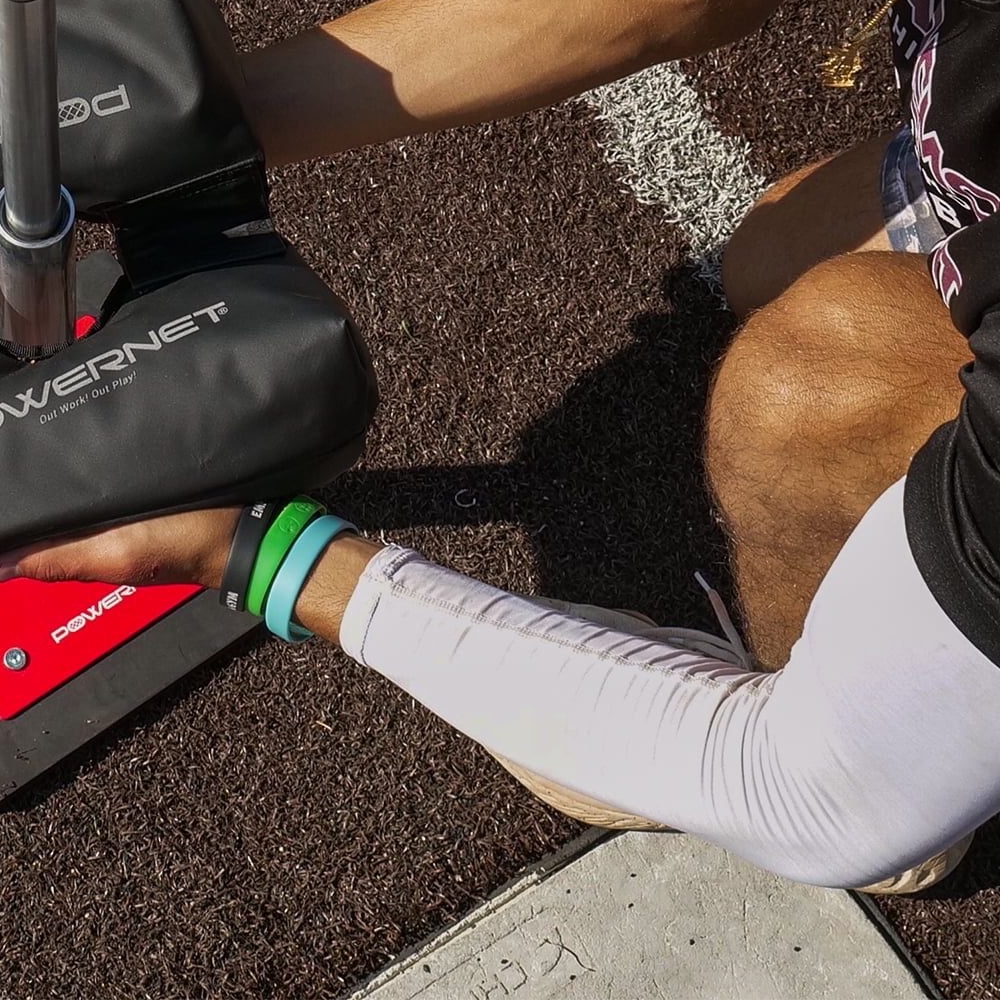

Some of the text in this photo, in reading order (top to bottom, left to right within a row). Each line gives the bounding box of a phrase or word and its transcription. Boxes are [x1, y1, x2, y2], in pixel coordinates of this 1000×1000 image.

[39, 370, 137, 424] Out Work! Out Play!
[50, 585, 137, 644] POWER
